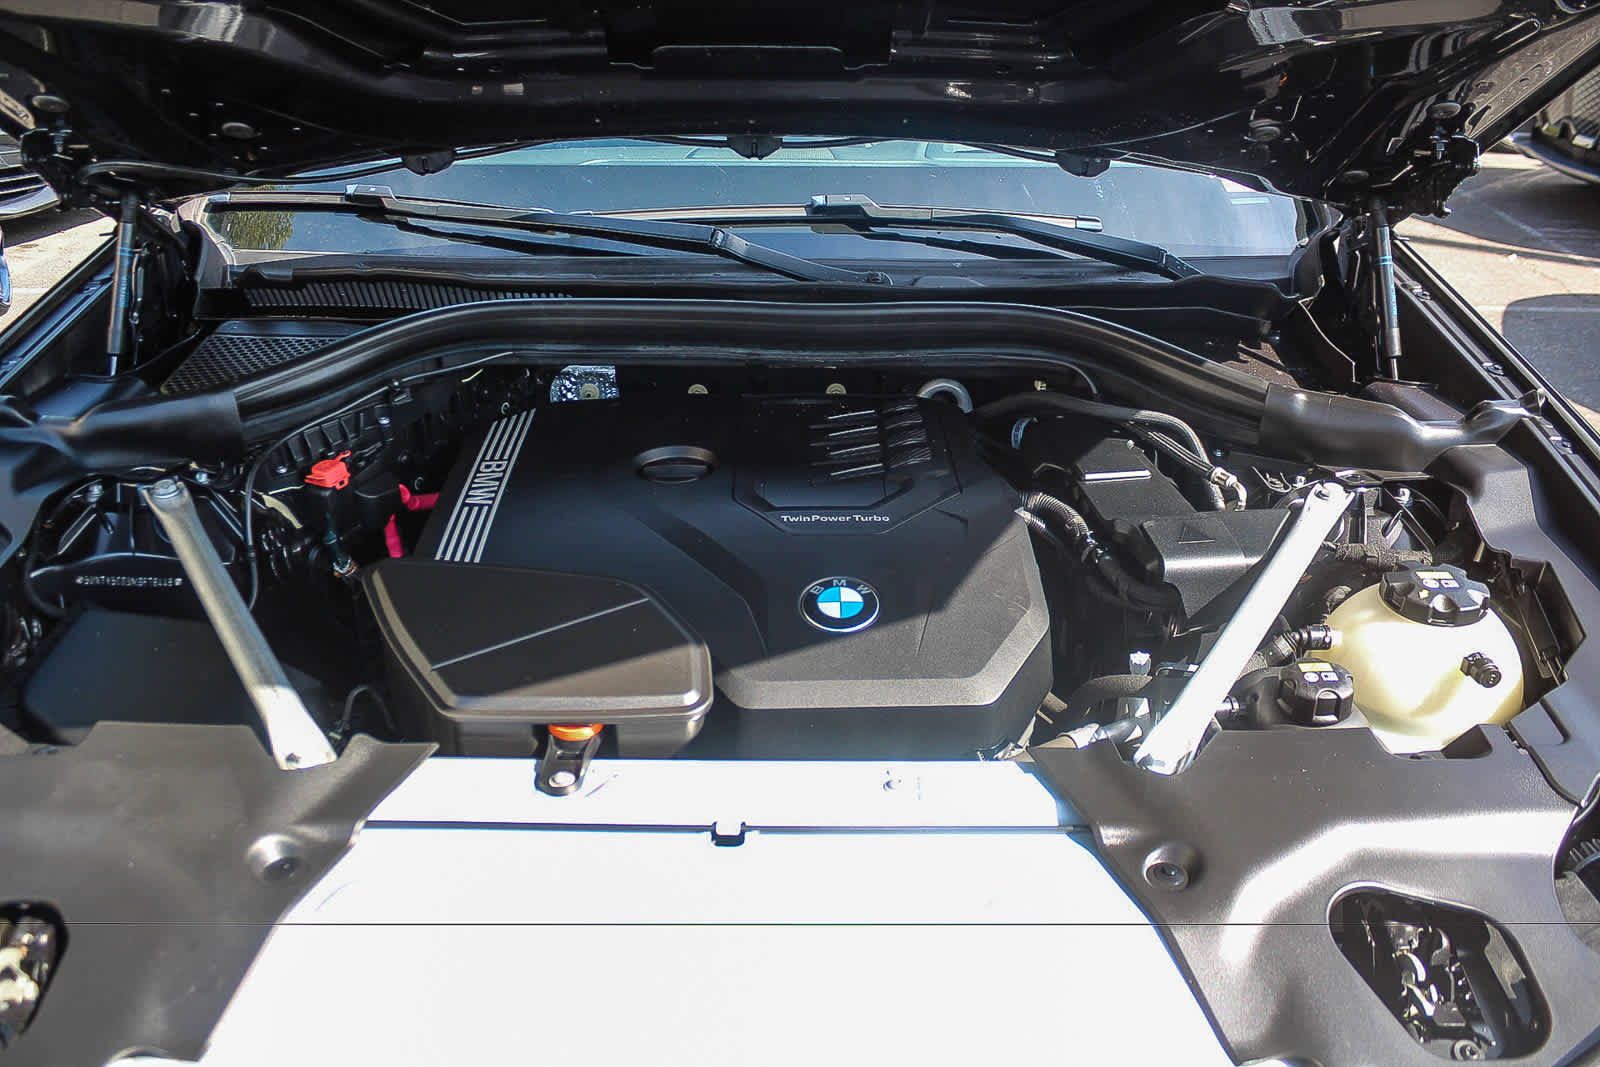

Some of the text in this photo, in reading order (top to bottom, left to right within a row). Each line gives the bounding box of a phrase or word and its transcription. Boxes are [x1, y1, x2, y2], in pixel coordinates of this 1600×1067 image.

[464, 460, 508, 505] BMW
[853, 514, 890, 523] Turbo
[809, 579, 872, 595] BMW
